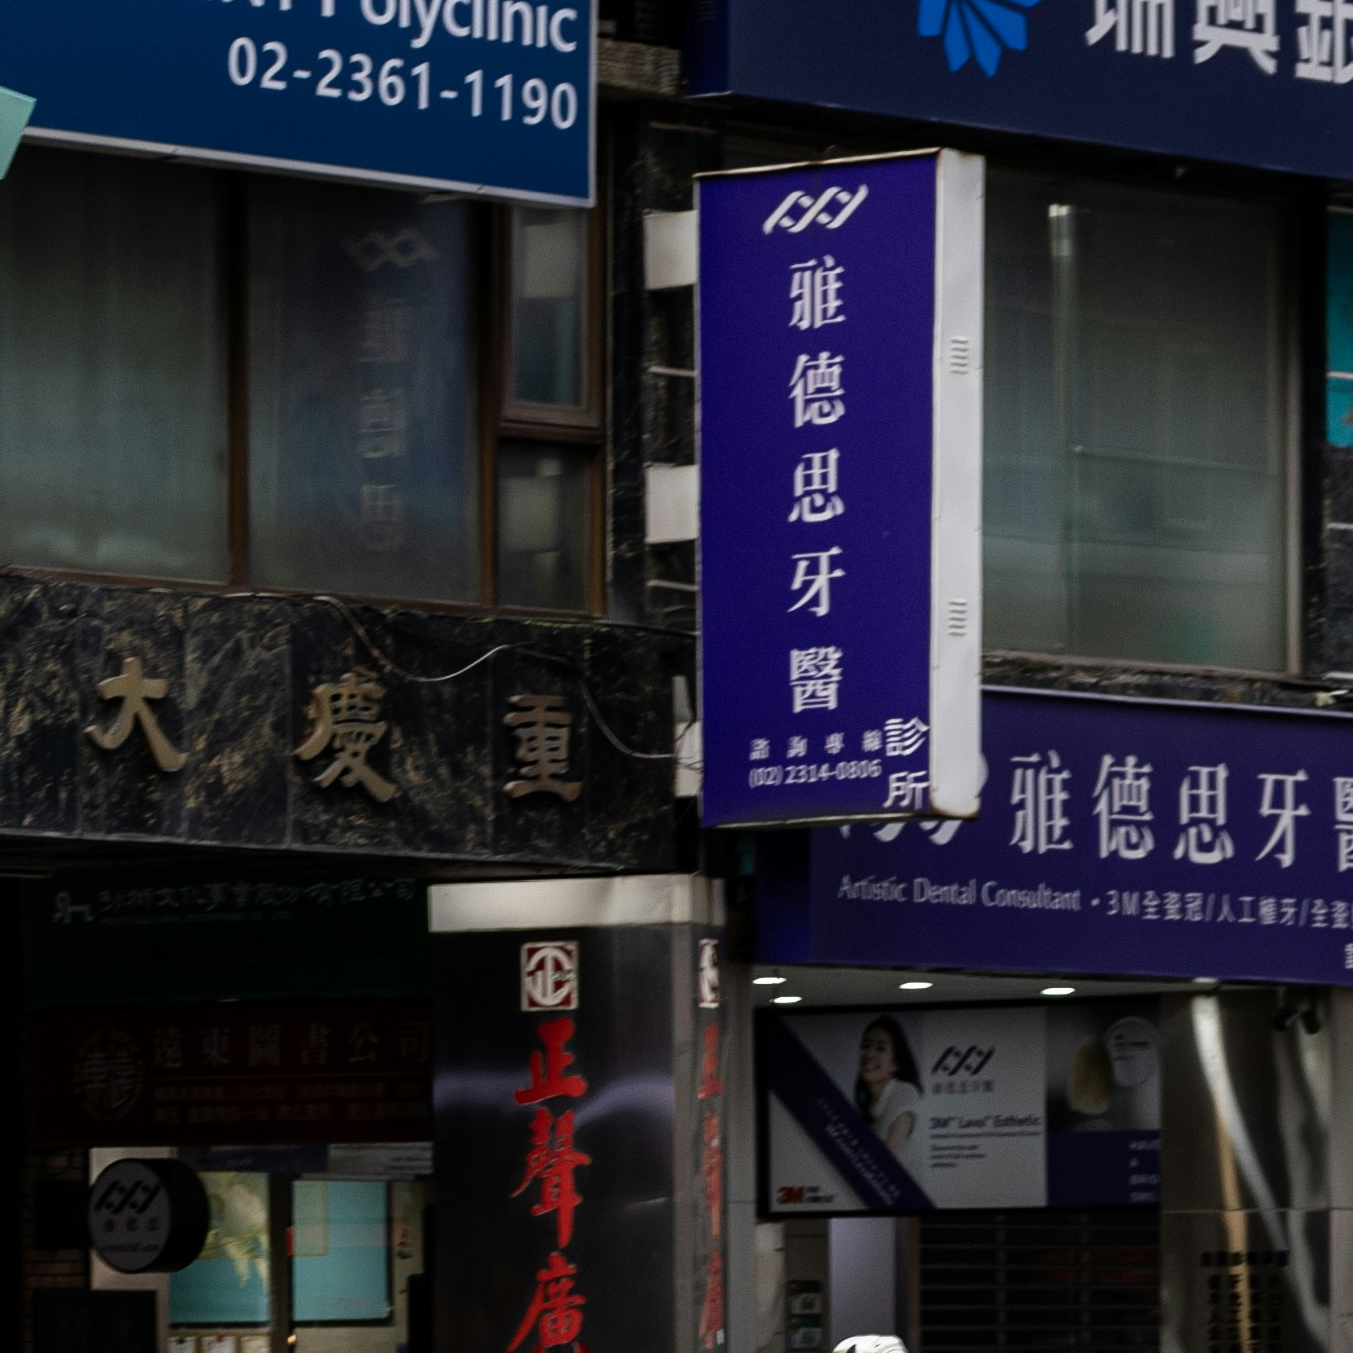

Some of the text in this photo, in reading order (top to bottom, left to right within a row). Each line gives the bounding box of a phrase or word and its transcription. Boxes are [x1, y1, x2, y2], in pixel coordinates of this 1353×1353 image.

[226, 35, 578, 130] 02-2361-1190
[787, 255, 847, 713] 雅德思牙醫
[882, 715, 931, 811] 診所
[837, 874, 908, 903] Artistic
[913, 878, 977, 905] Dental
[981, 882, 1082, 913] Consultant
